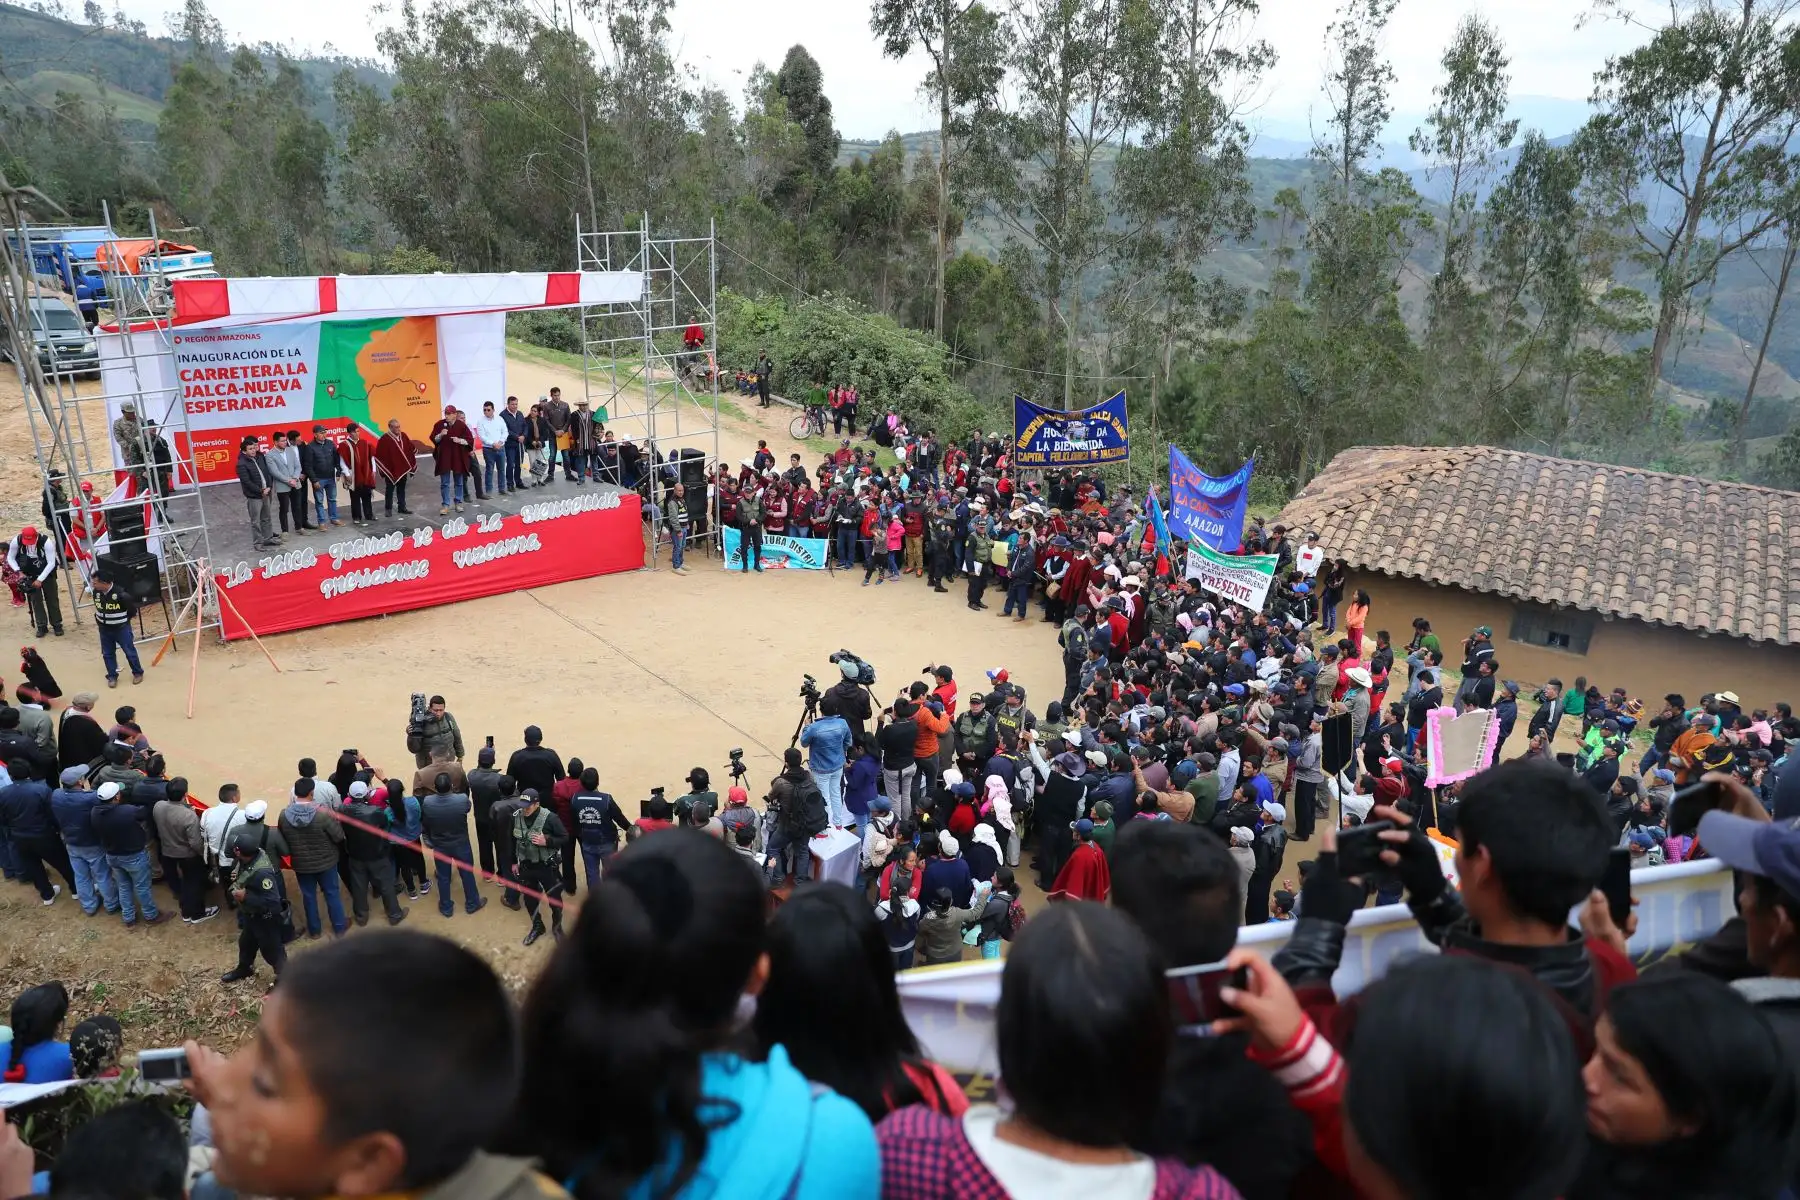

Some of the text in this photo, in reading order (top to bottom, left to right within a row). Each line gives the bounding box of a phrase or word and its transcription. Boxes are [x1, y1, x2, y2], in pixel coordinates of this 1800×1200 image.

[185, 333, 261, 343] REGIÓN AMAZONAS
[178, 348, 301, 363] INAUGURACIÓN DE LA
[180, 362, 308, 382] CARRETERA LA
[184, 378, 302, 398] JALCA-NUEVA
[185, 395, 286, 414] ESPERANZA
[1036, 441, 1050, 451] LA
[413, 526, 433, 548] te
[1201, 572, 1253, 602] PRESENTE
[998, 717, 1016, 728] POLICIA
